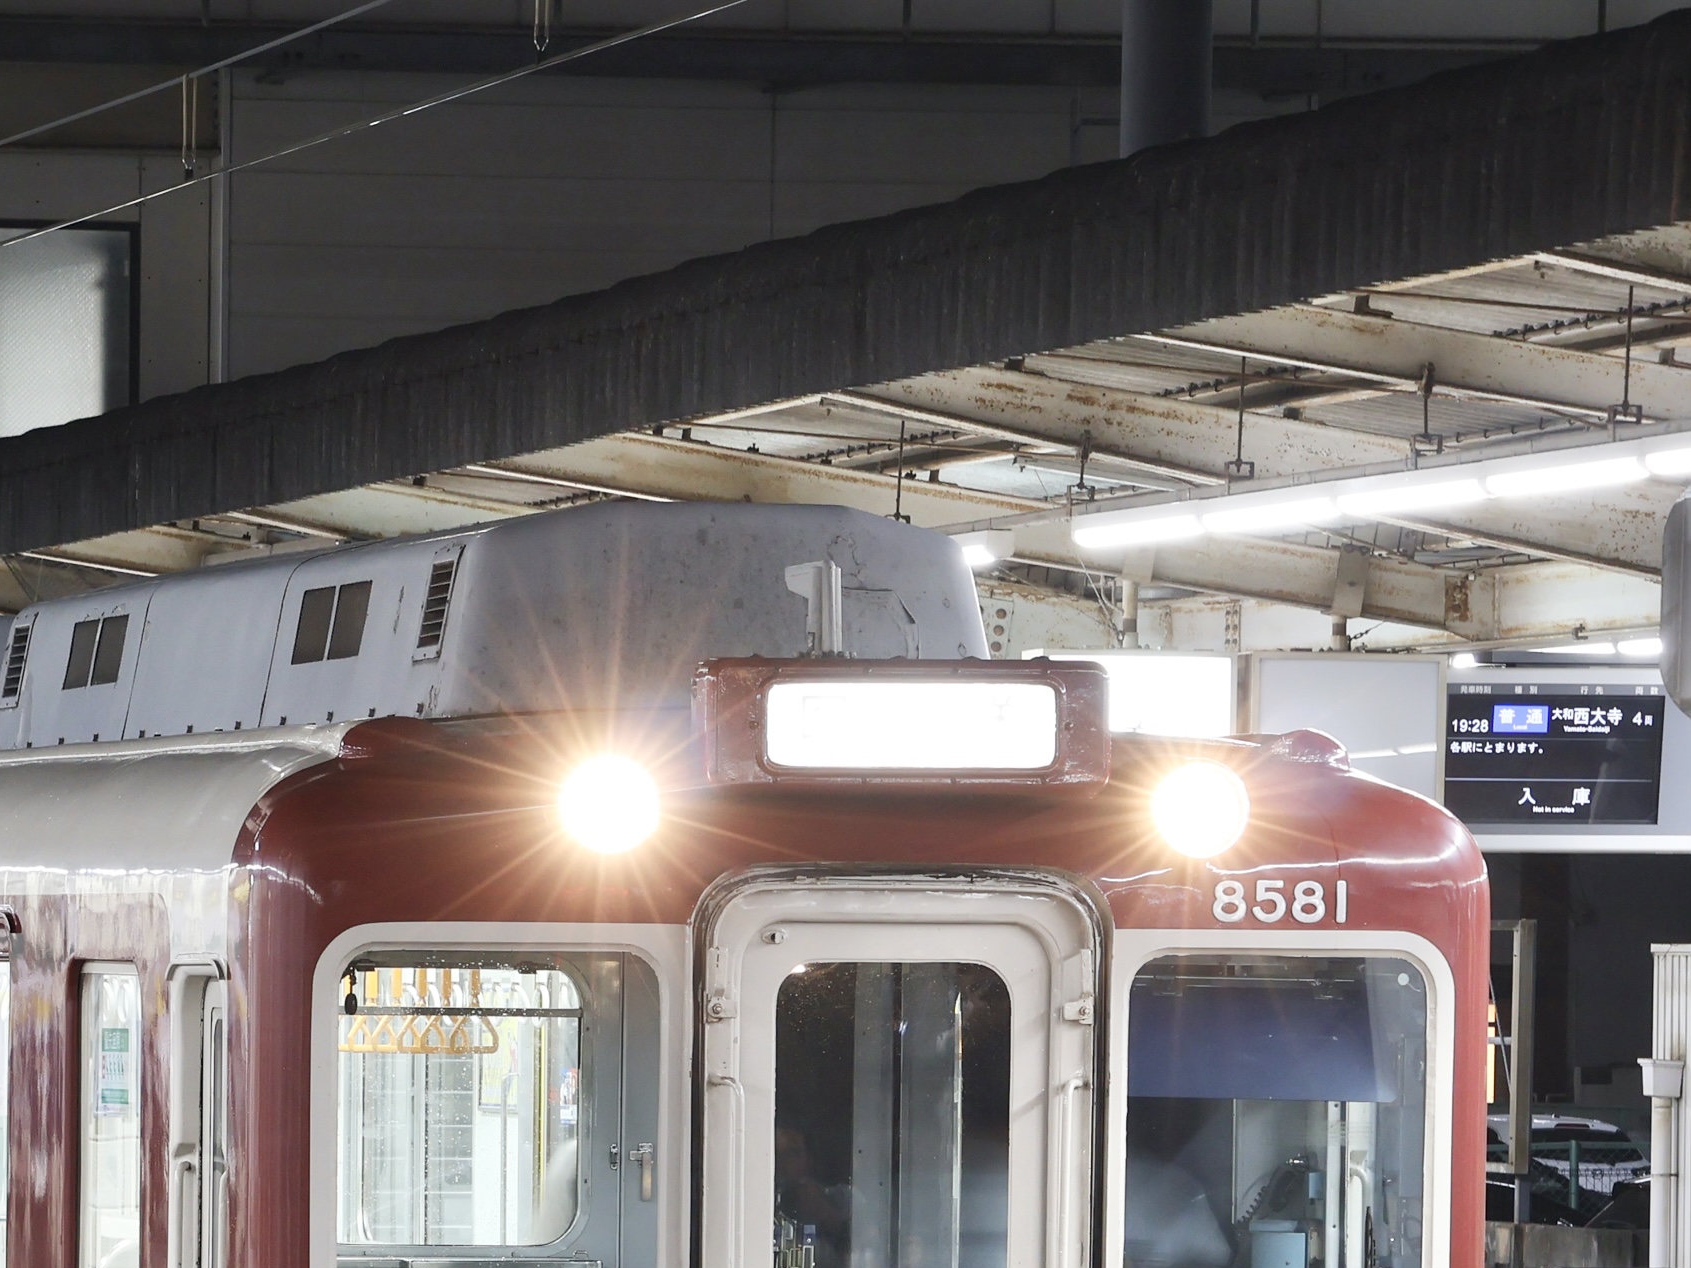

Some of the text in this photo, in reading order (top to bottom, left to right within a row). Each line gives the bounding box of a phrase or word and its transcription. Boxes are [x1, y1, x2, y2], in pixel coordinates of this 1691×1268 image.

[1451, 718, 1489, 733] 19:28
[1551, 706, 1623, 726] 大和西大寺
[1450, 741, 1544, 754] 各駅にとまります。
[1212, 879, 1348, 924] 8581
